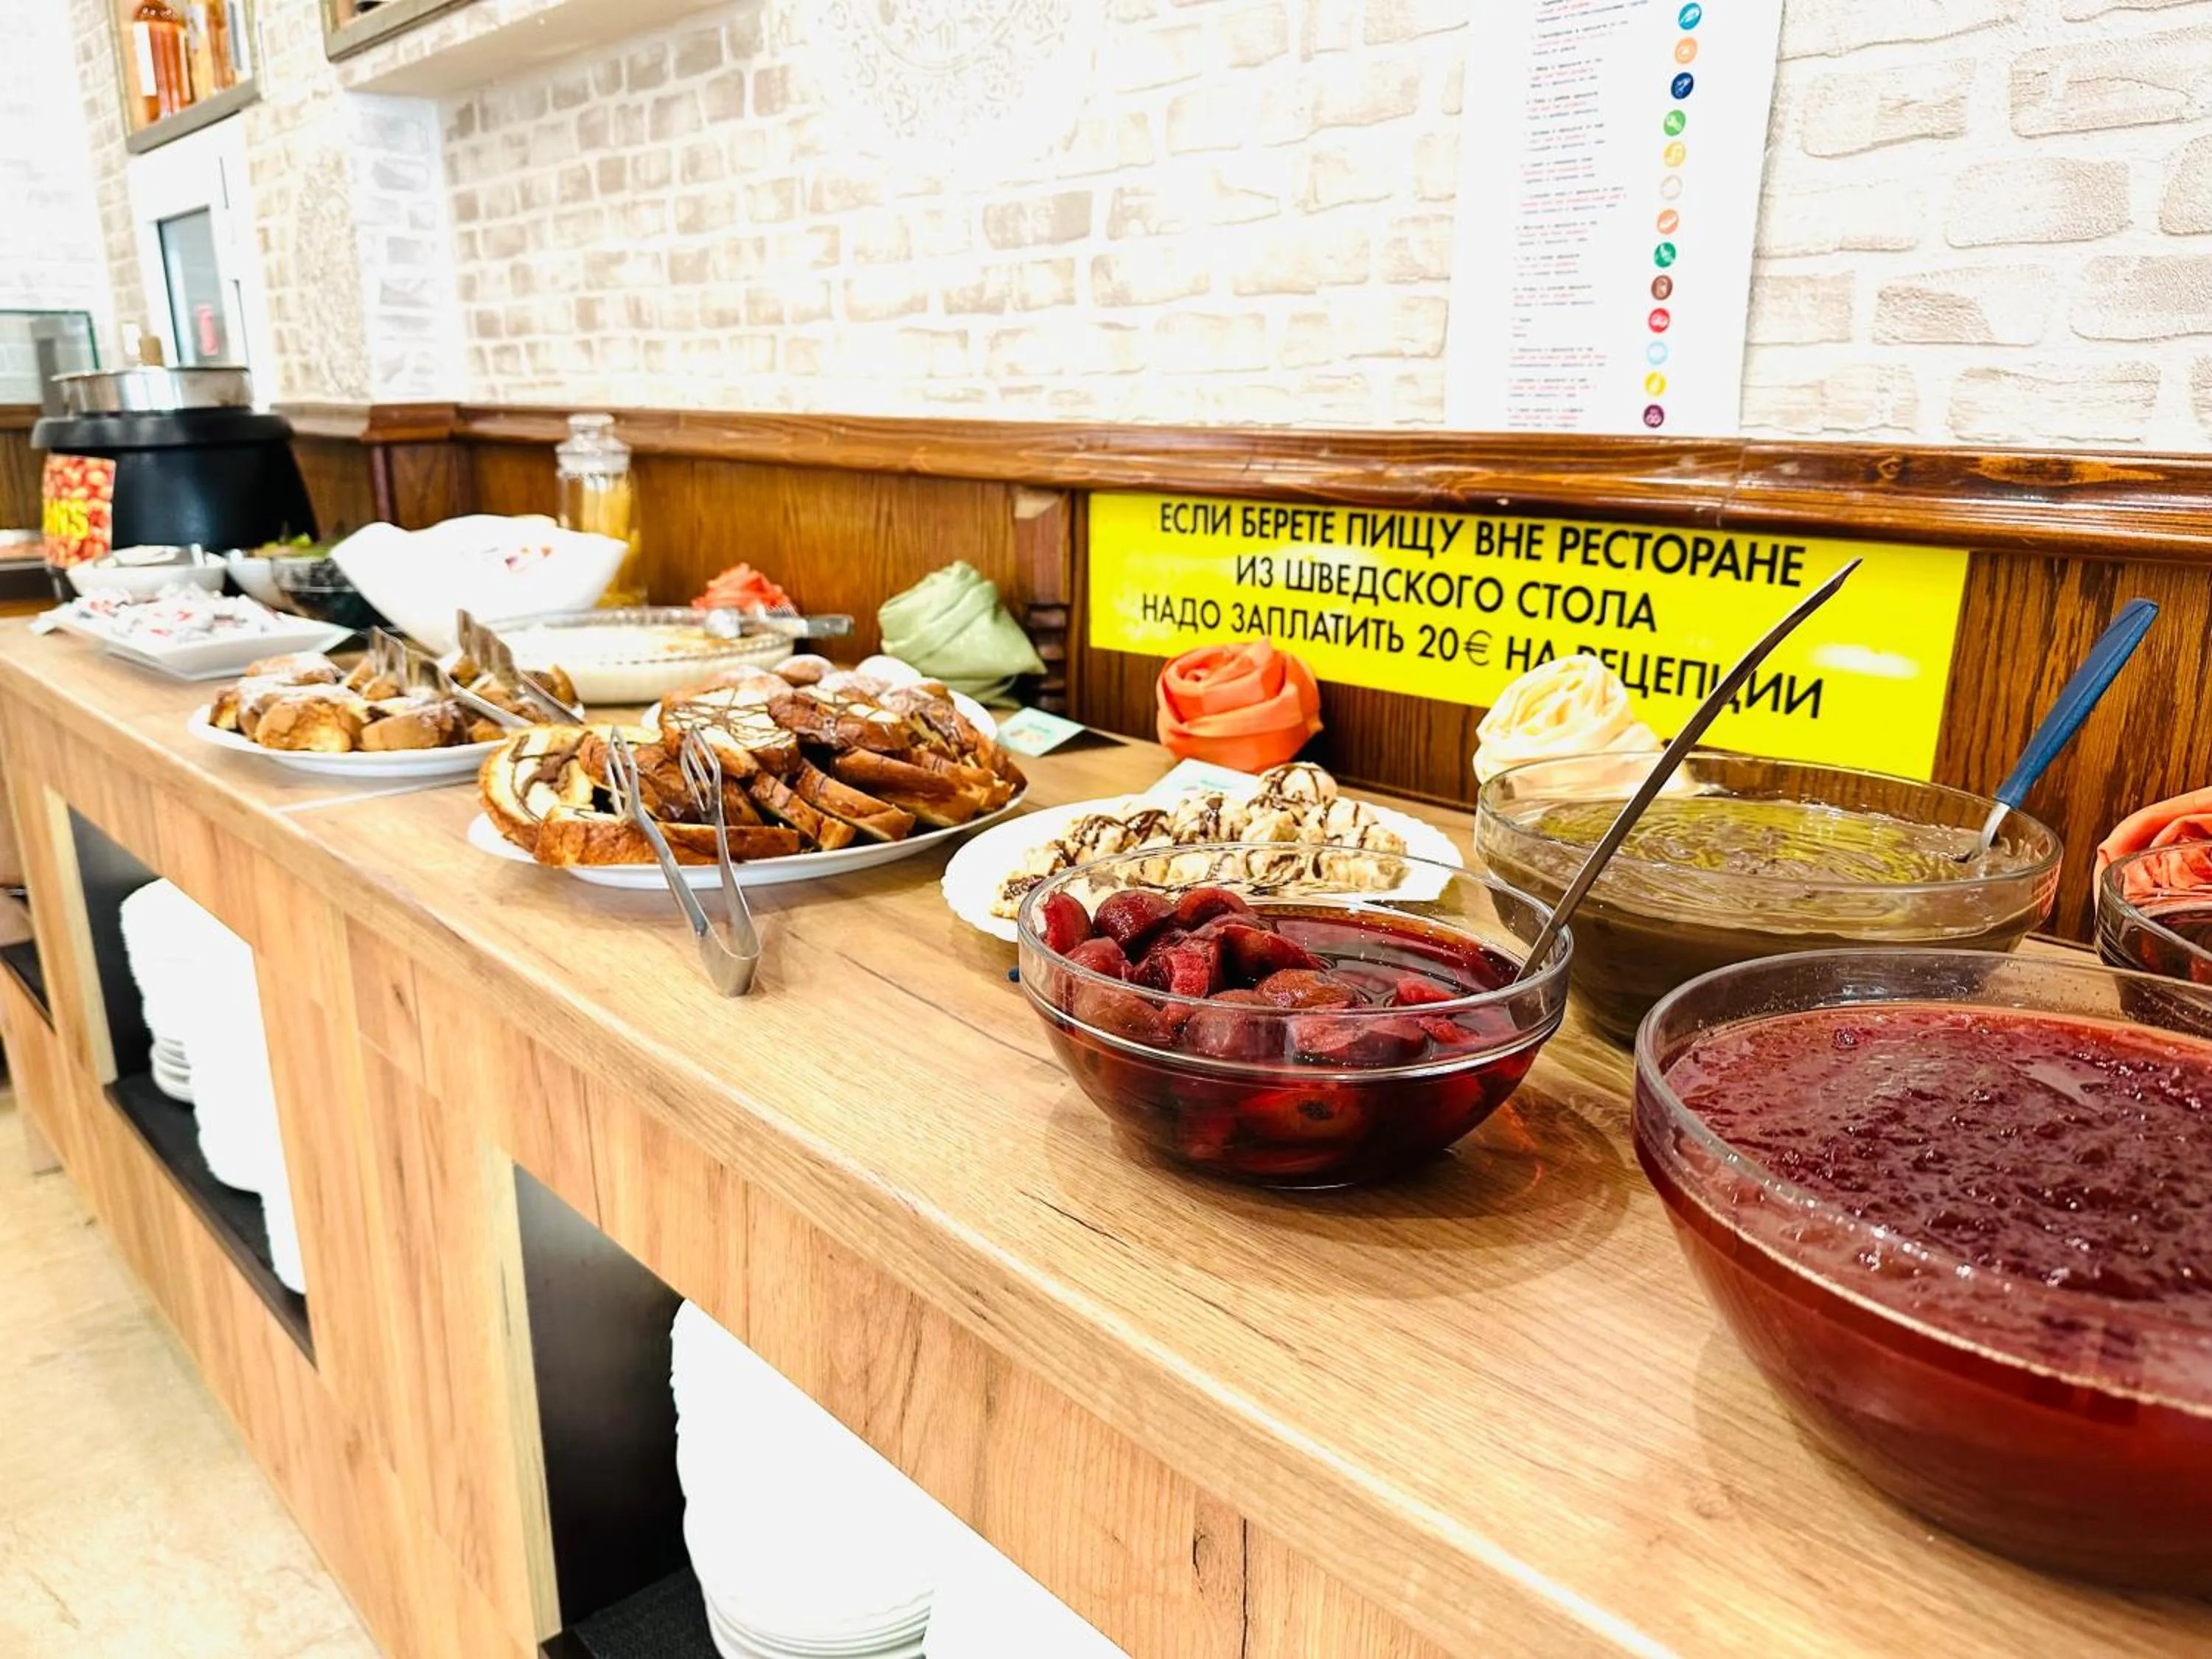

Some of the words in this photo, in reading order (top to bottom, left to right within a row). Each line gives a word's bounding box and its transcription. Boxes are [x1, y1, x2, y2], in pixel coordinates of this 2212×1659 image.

[1160, 502, 1232, 537] ЕСЛИ
[1241, 506, 1337, 544] БЕРЕТЕ
[1346, 512, 1465, 560] ПИЩУ
[1475, 519, 1546, 562] ВНЕ
[1557, 524, 1807, 588] РЕСТОРАНЕ
[1236, 554, 1274, 589] ИЗ
[1284, 558, 1505, 614] ШВЕДСКОГО
[1516, 580, 1658, 633] СТОЛА
[1142, 594, 1221, 633] НАДО
[1231, 602, 1405, 653] ЗАПЛАТИТЬ
[1505, 635, 1556, 674] НА
